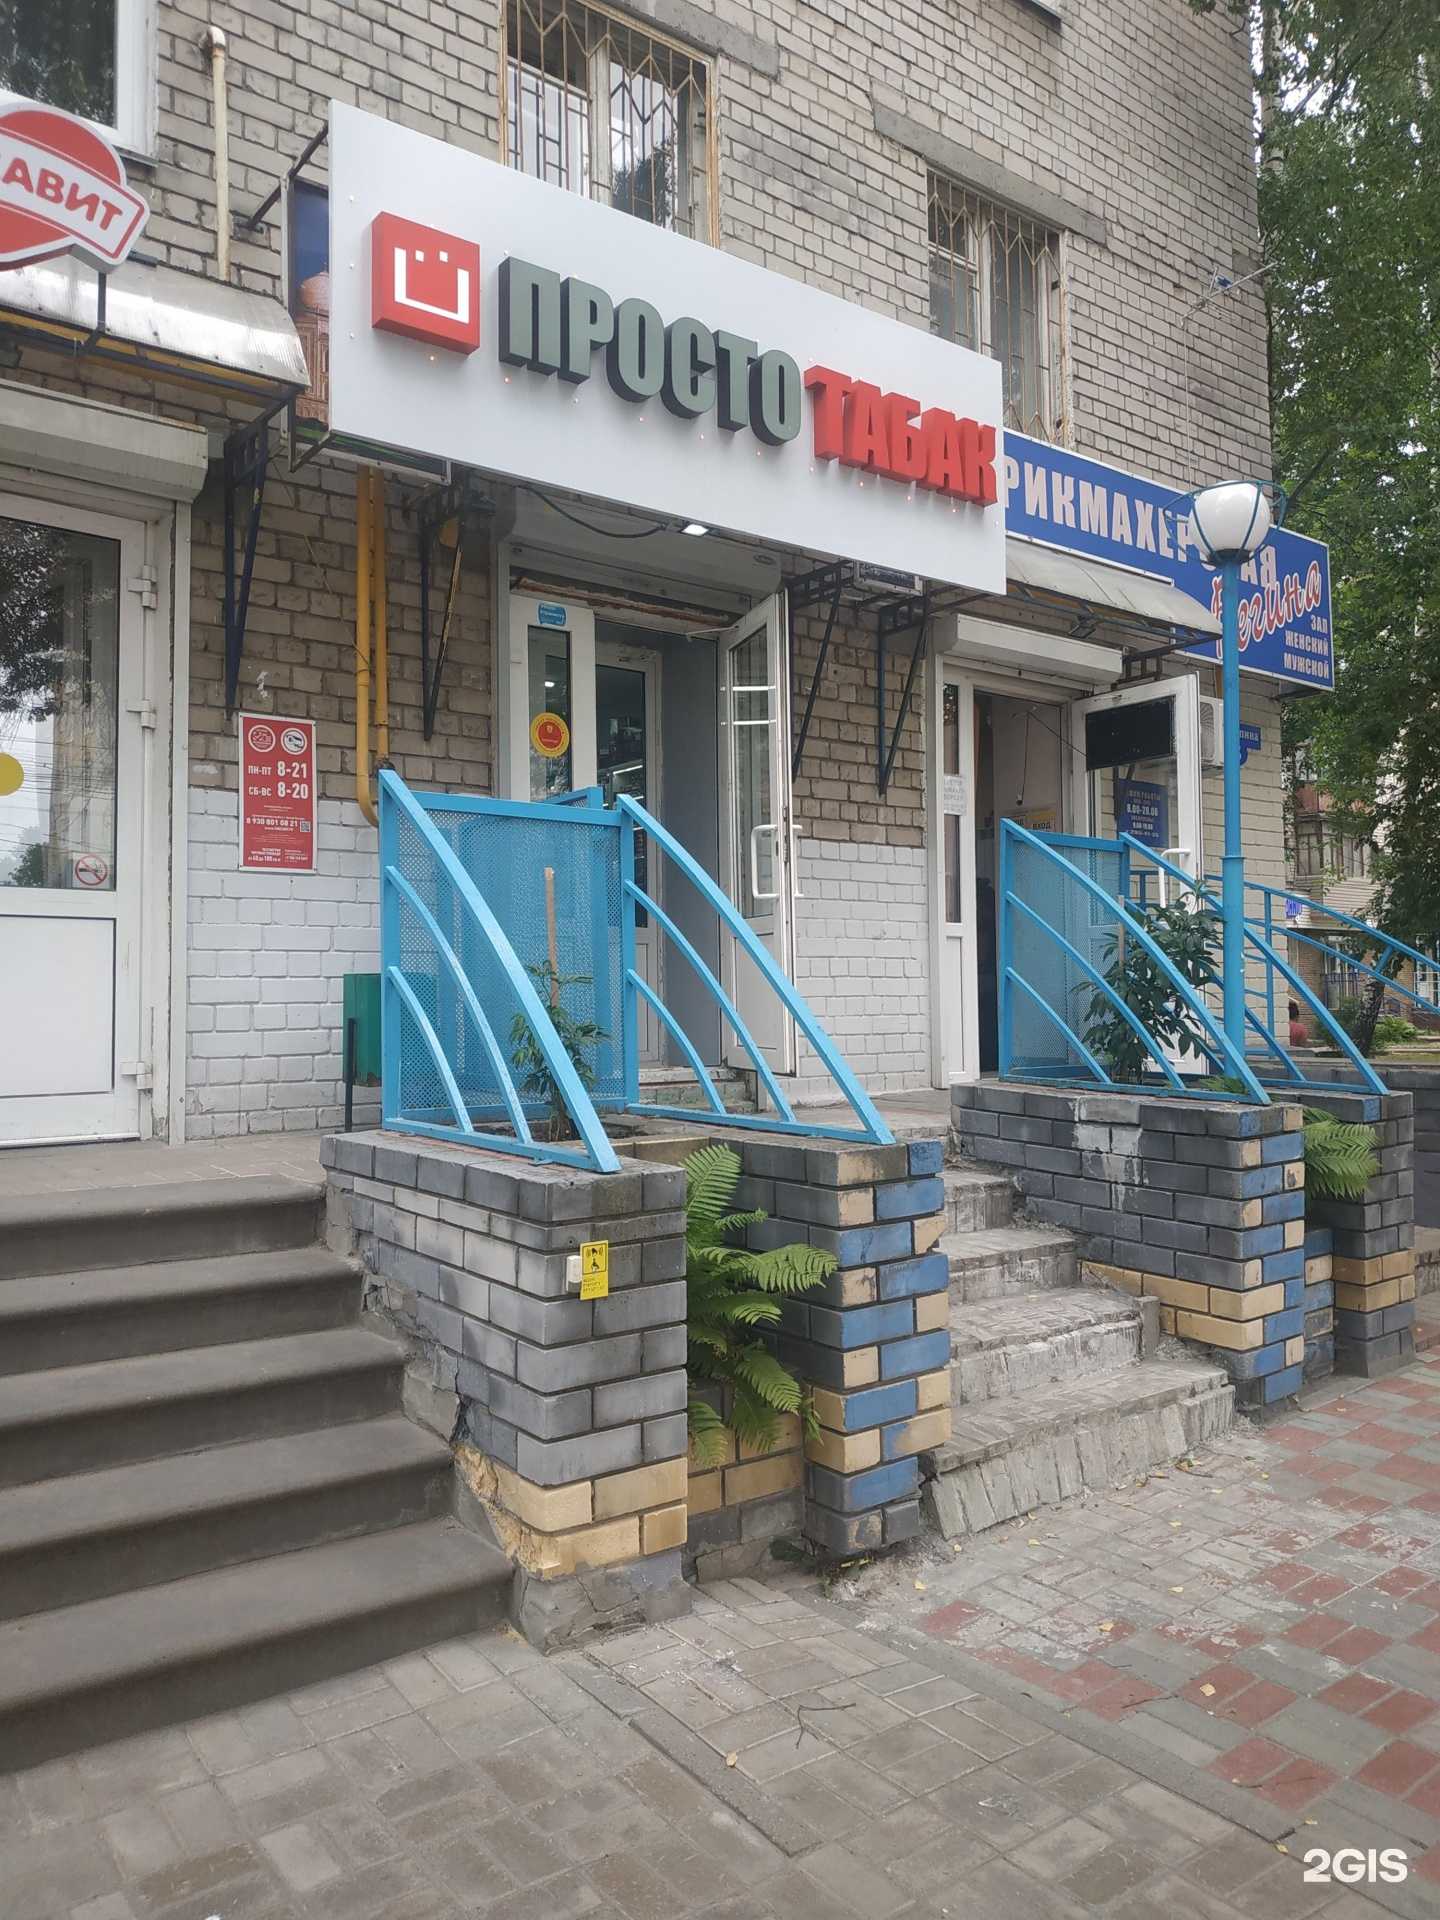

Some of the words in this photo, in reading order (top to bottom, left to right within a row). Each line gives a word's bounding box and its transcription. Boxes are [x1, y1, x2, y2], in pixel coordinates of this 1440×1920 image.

[2, 157, 124, 231] АВИТ
[499, 256, 801, 446] ПРОСТО
[804, 365, 998, 507] ТАБАК
[1002, 455, 1277, 588] РИКМАХЕРАЯ
[1310, 615, 1329, 633] ЗАЛ
[1285, 630, 1329, 657] ЖЕНСКИЙ
[1284, 652, 1329, 680] МУЖСКОЙ
[248, 765, 272, 776] ПН-ПТ
[277, 761, 307, 779] 8-21
[248, 786, 272, 797] СБ-ВС
[277, 782, 309, 799] 8-20
